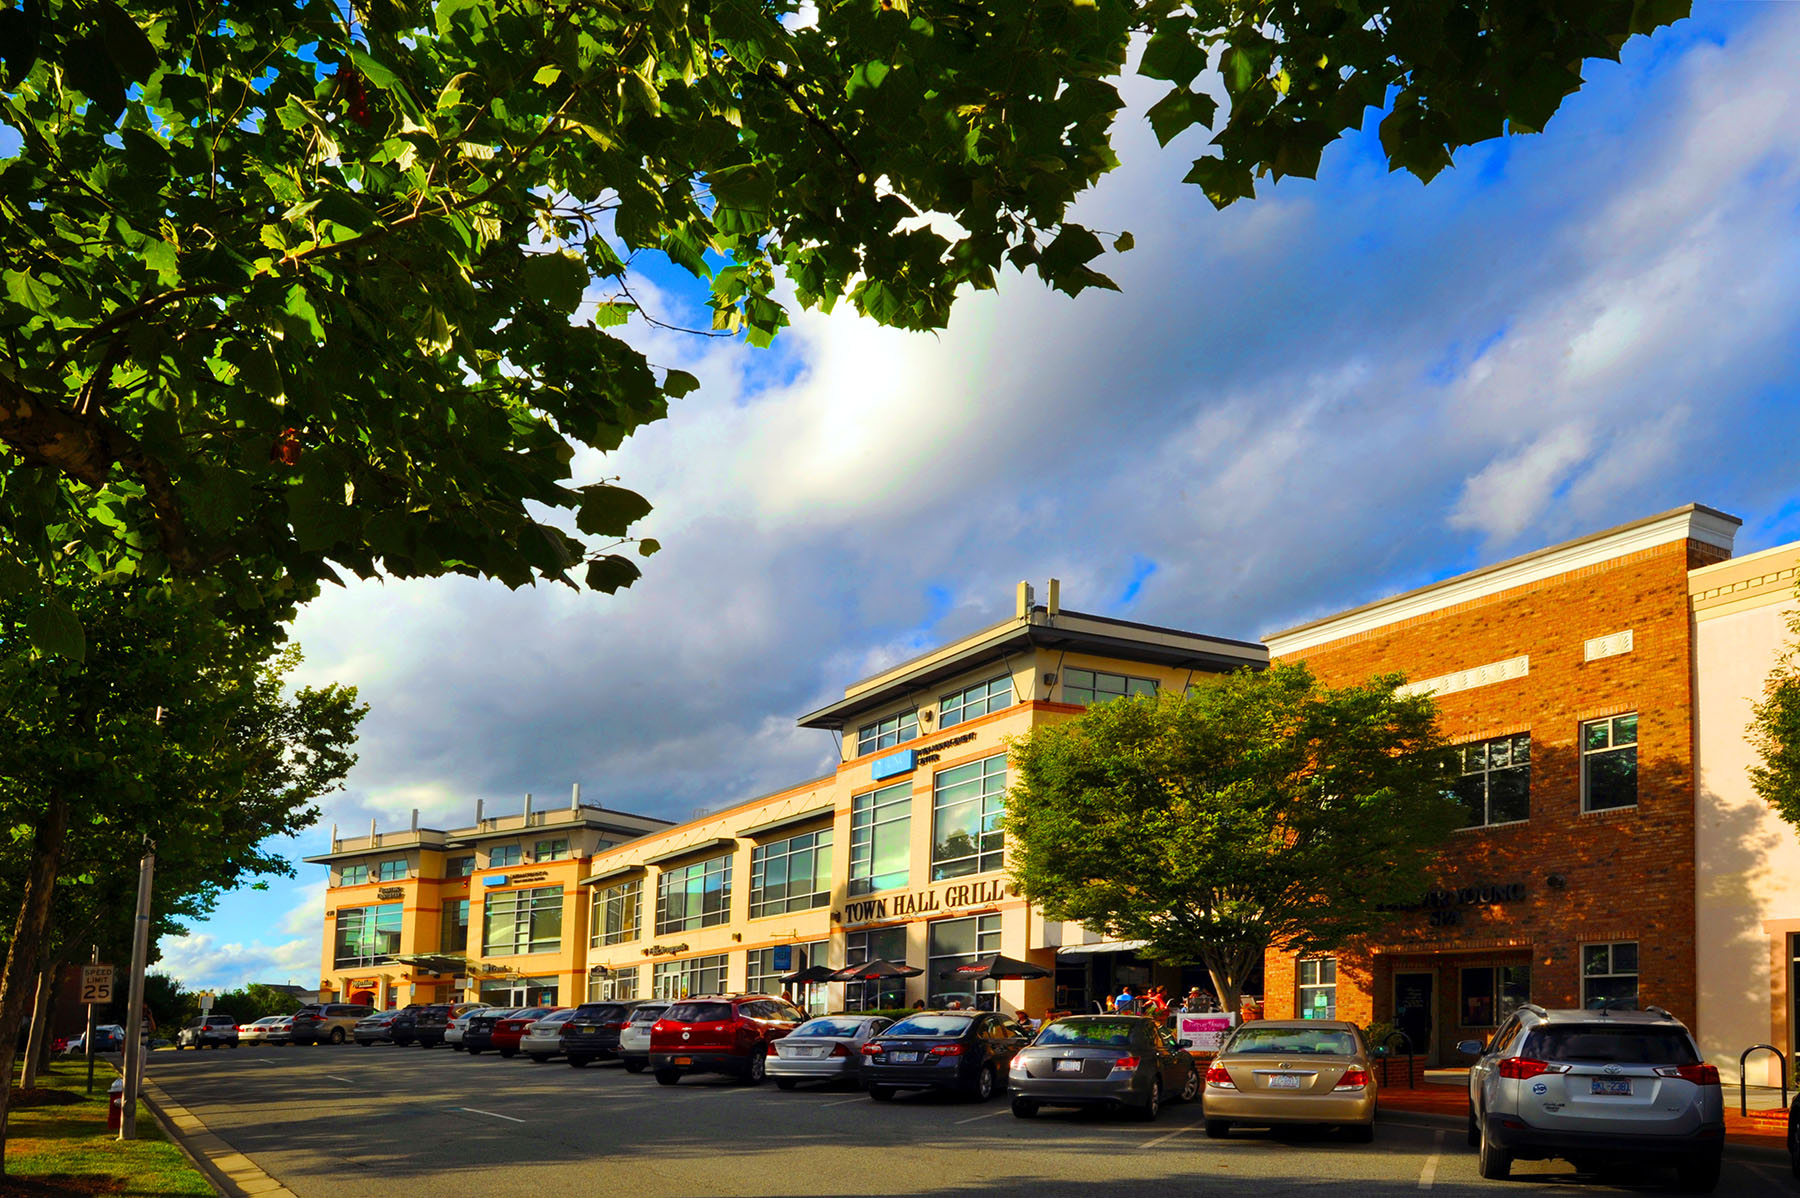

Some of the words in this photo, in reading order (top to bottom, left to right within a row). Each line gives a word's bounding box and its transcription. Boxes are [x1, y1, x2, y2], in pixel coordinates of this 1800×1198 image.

[845, 897, 887, 923] TOWN
[893, 890, 939, 916] HALL
[945, 879, 1004, 908] GRILL
[87, 976, 108, 984] LIMIT
[84, 984, 109, 999] 25
